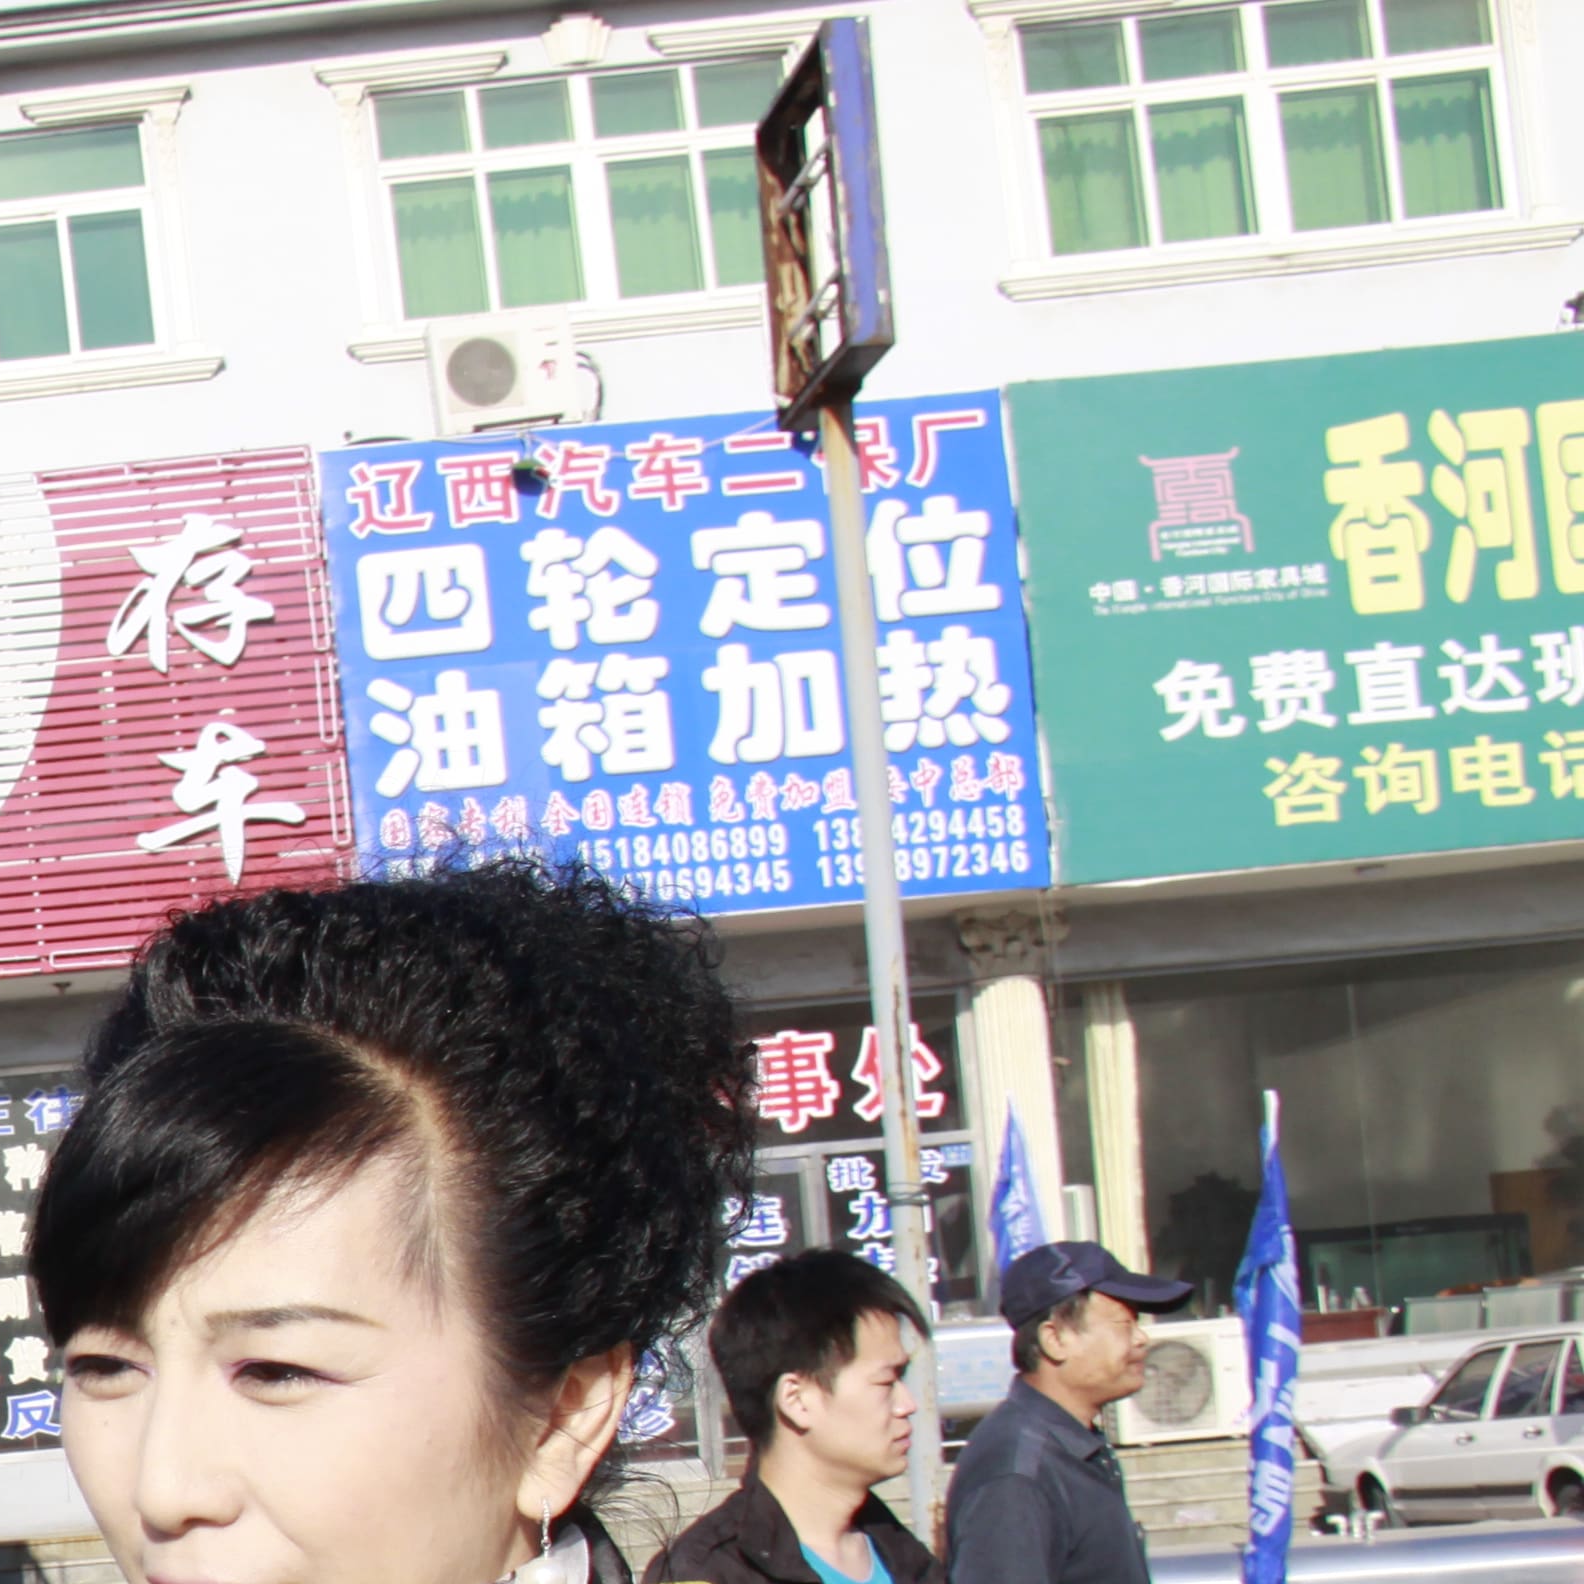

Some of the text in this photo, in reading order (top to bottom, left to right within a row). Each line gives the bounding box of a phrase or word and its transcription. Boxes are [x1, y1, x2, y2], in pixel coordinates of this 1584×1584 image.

[356, 495, 1002, 661] 四轮定位
[366, 624, 1012, 798] 油箱加热
[812, 803, 1027, 852] 1384294458
[817, 840, 1031, 888] 1398972346
